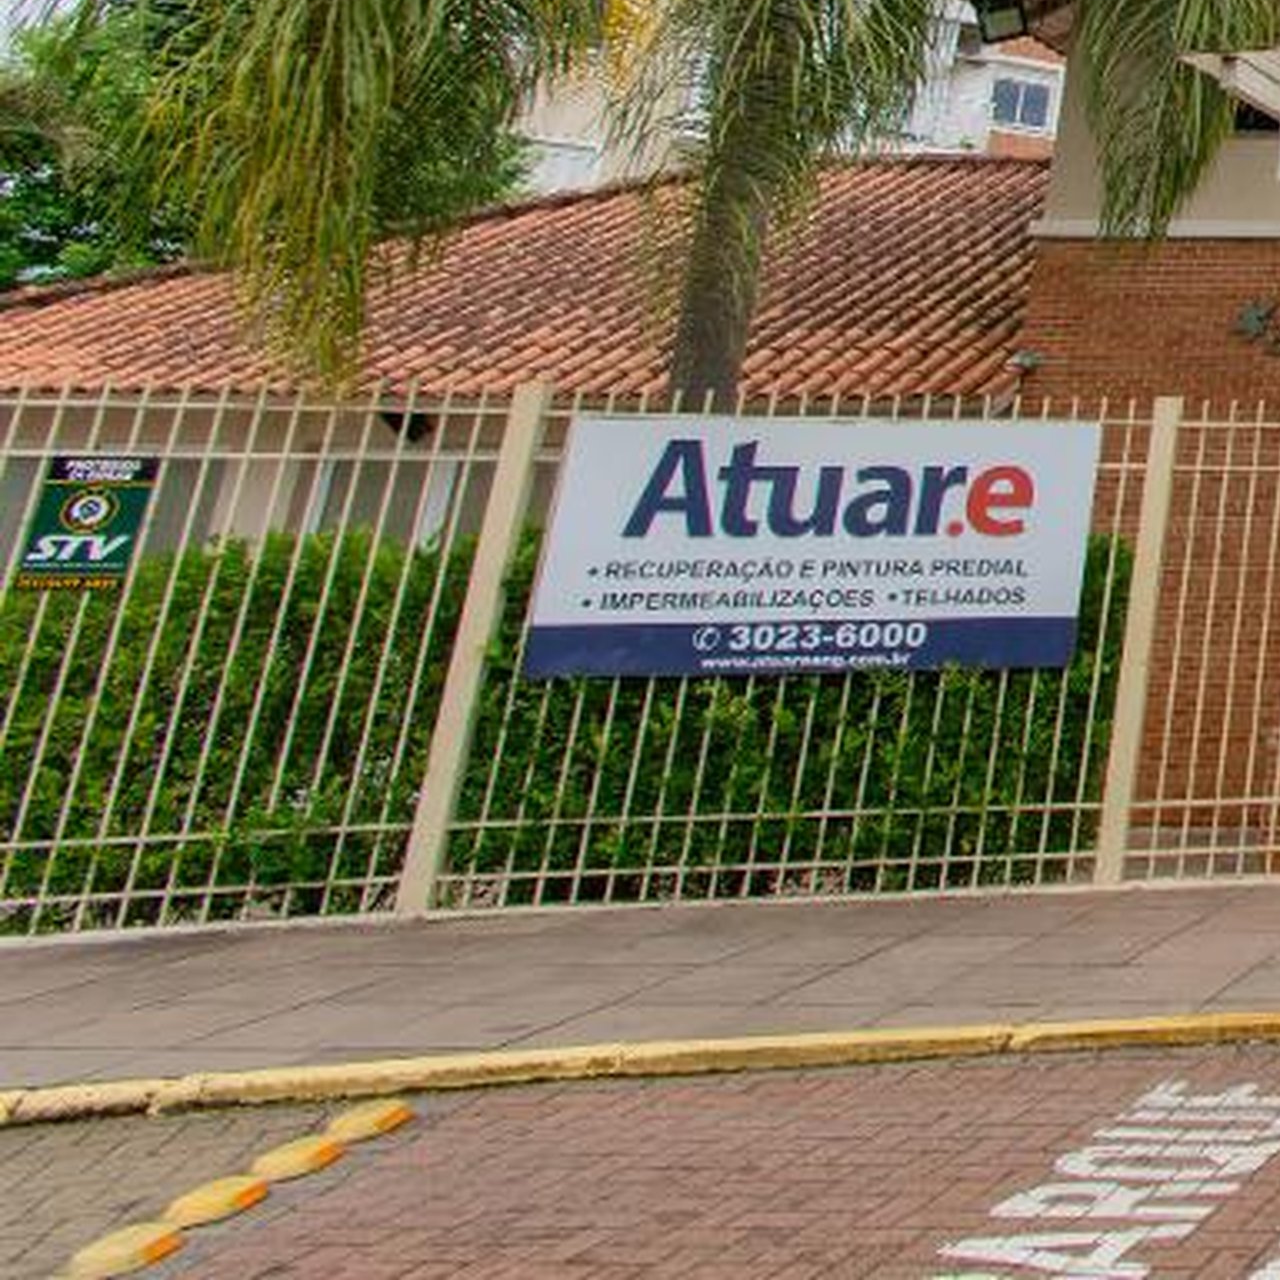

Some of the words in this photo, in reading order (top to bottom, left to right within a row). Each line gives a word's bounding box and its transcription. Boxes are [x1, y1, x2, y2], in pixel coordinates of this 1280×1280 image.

[25, 534, 130, 561] STV
[605, 558, 796, 584] RECUPERAÇÃO
[799, 559, 817, 578] E
[821, 558, 926, 579] PINTURA
[930, 557, 1029, 578] PREDIAL
[728, 622, 928, 651] 3023-6000
